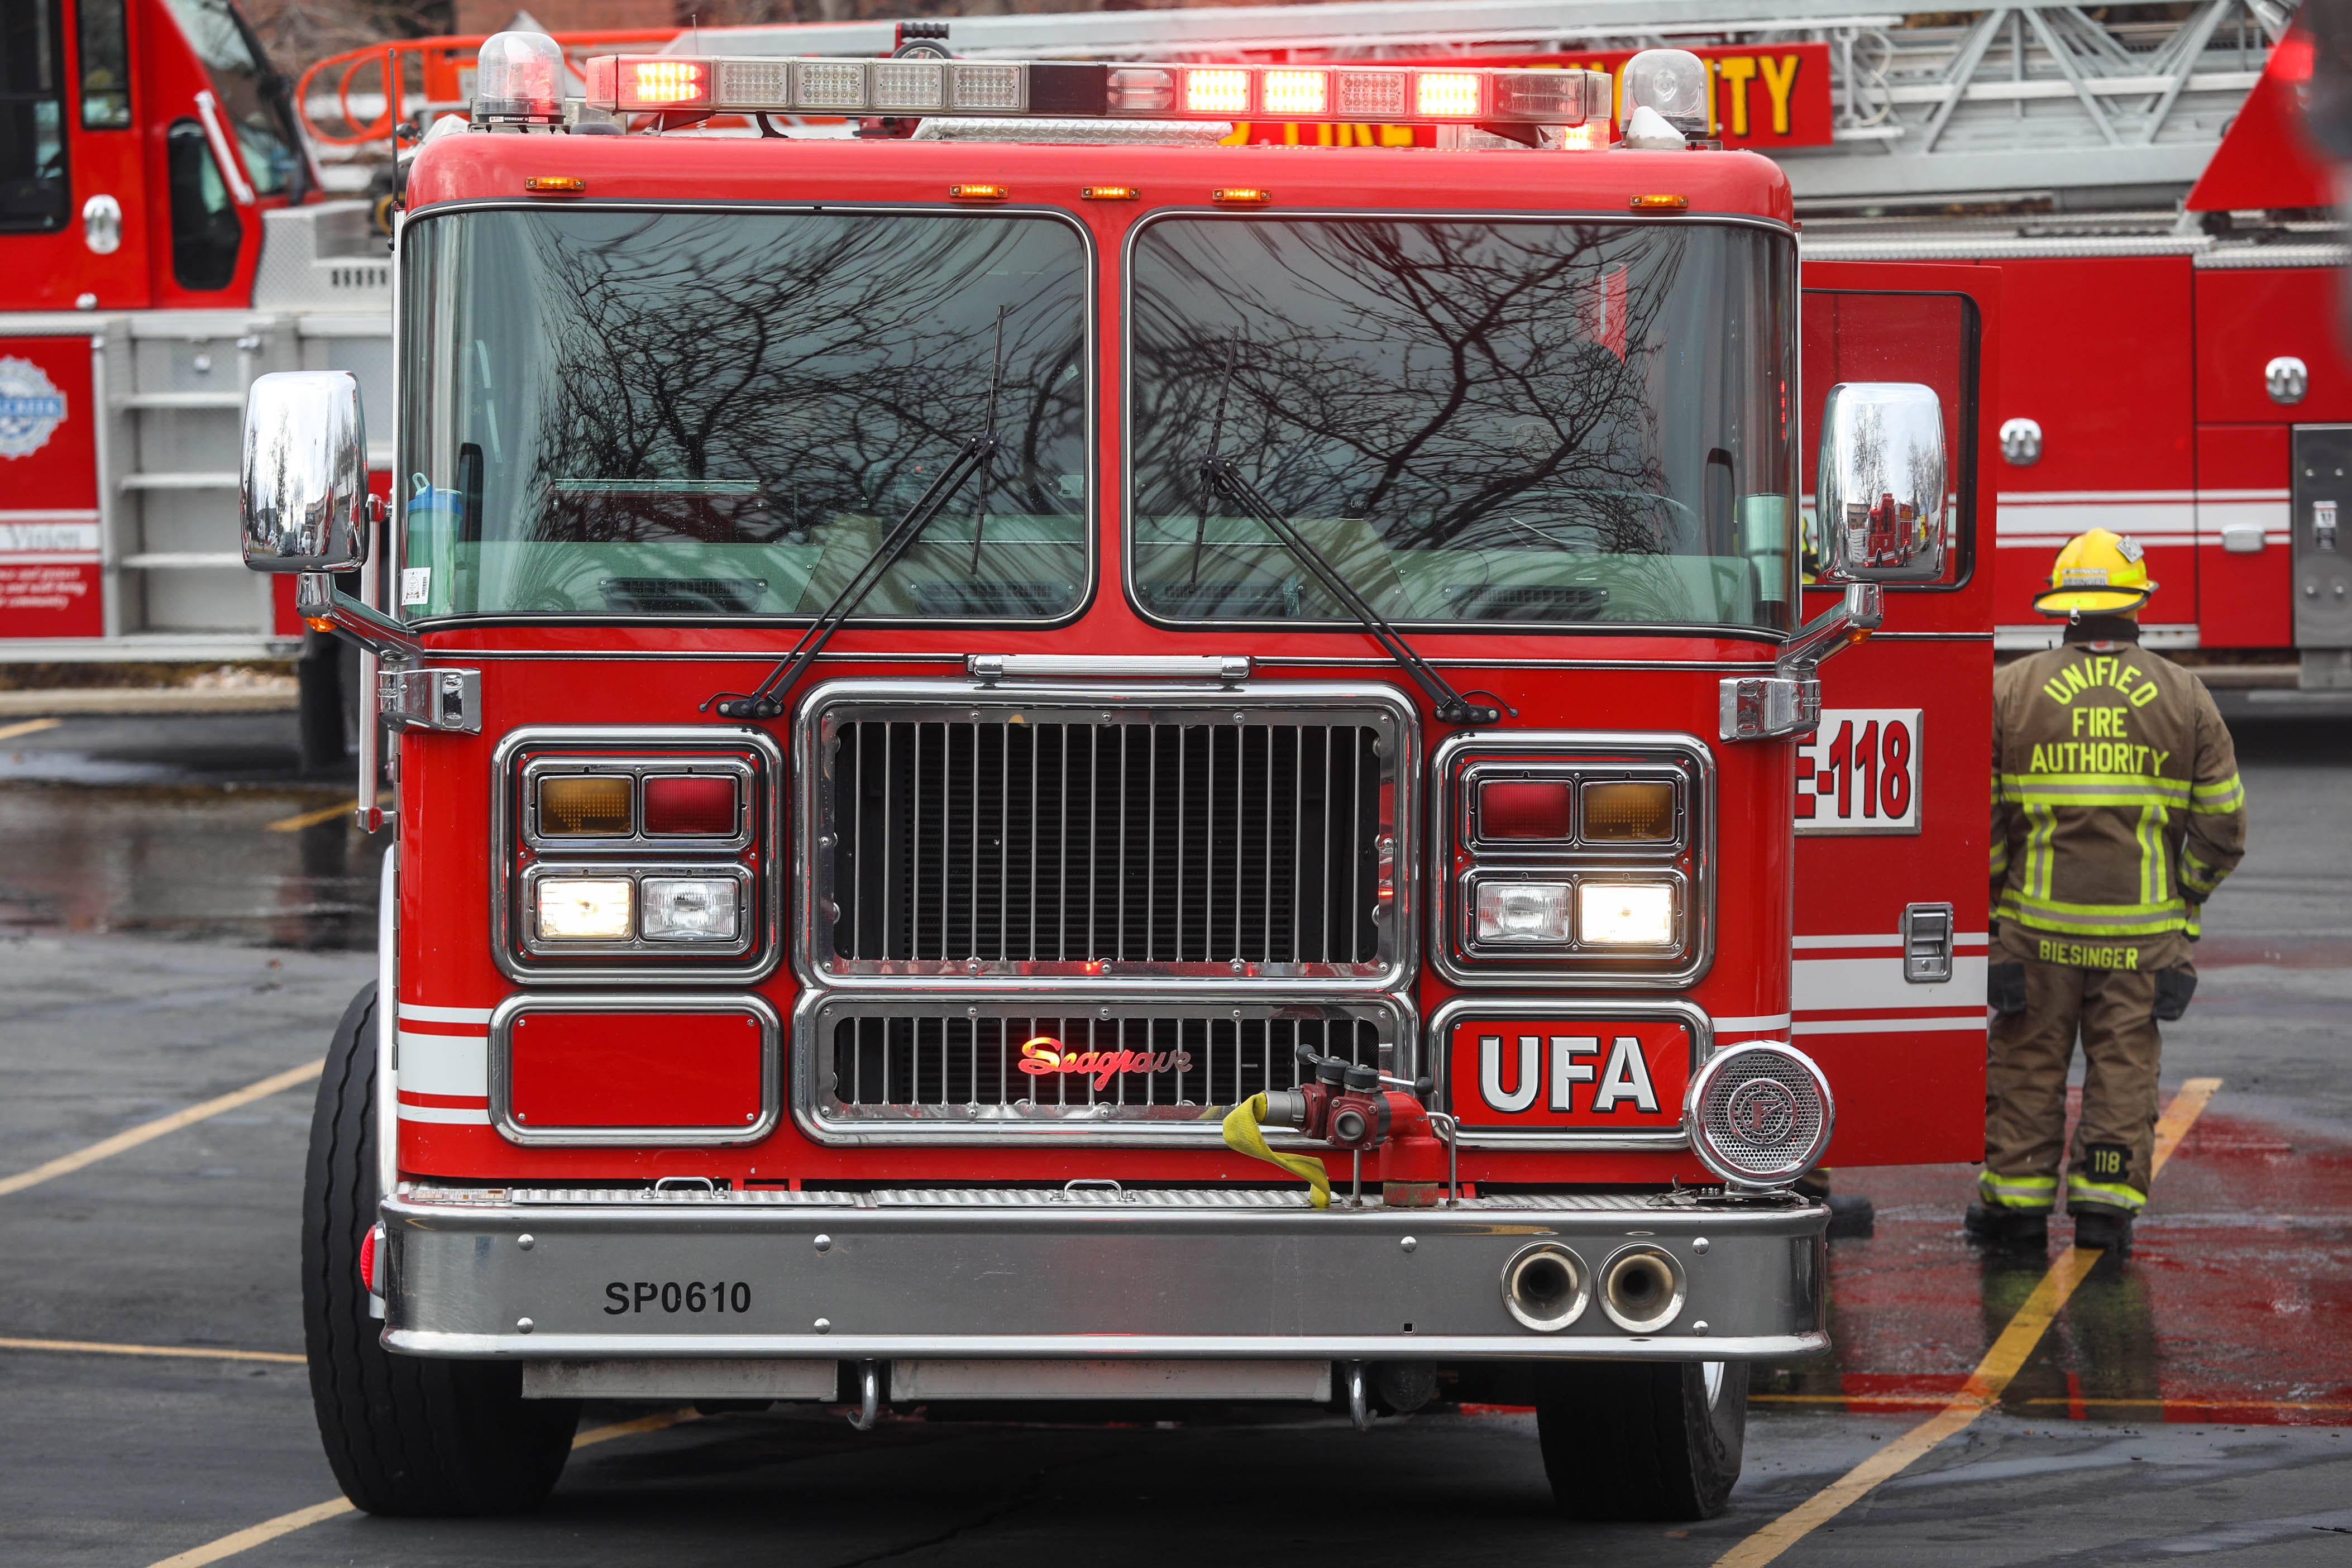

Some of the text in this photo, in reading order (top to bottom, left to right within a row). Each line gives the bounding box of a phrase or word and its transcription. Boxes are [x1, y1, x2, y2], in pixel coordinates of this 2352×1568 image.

[2043, 656, 2158, 707] UNIFIED
[2072, 707, 2128, 738] FIRE
[1794, 720, 1911, 820] E-118
[2030, 742, 2169, 777] AUTHORITY
[2039, 939, 2138, 970] BIESINGER
[1018, 1036, 1193, 1091] Seagrave
[1479, 1035, 1662, 1113] UFA
[2095, 1150, 2120, 1174] 118
[603, 1282, 752, 1315] SP0610
